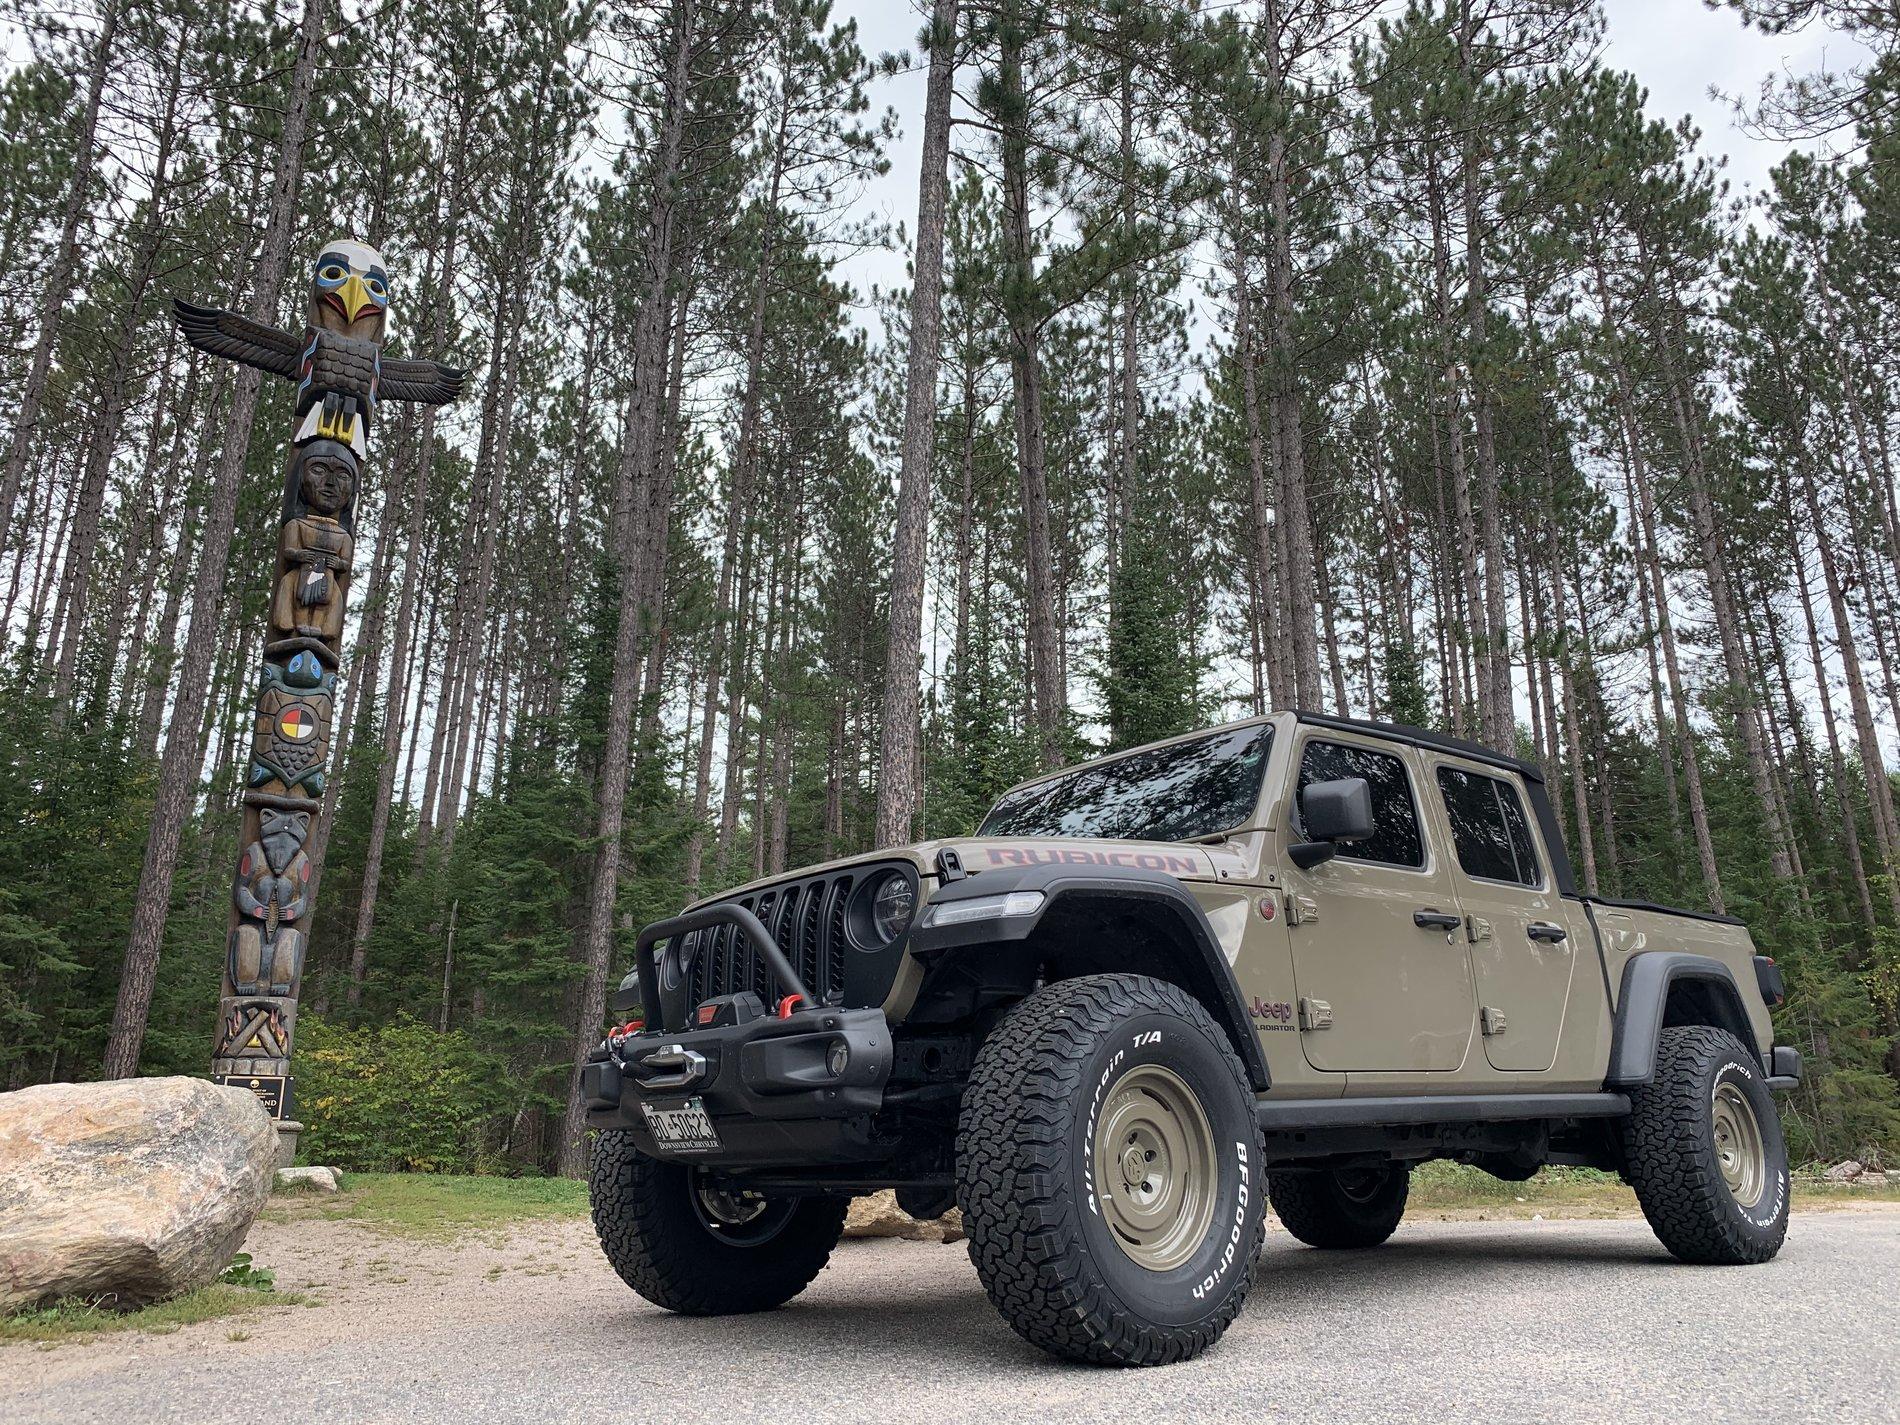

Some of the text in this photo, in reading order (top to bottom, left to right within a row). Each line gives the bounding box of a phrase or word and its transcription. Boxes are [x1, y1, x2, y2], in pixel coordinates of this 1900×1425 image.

[985, 848, 1198, 874] RUBICON
[1248, 996, 1291, 1023] Jeep
[1086, 1049, 1124, 1217] All-Terrain
[1132, 1030, 1162, 1049] T/A
[1191, 1140, 1249, 1300] BFGoodrich
